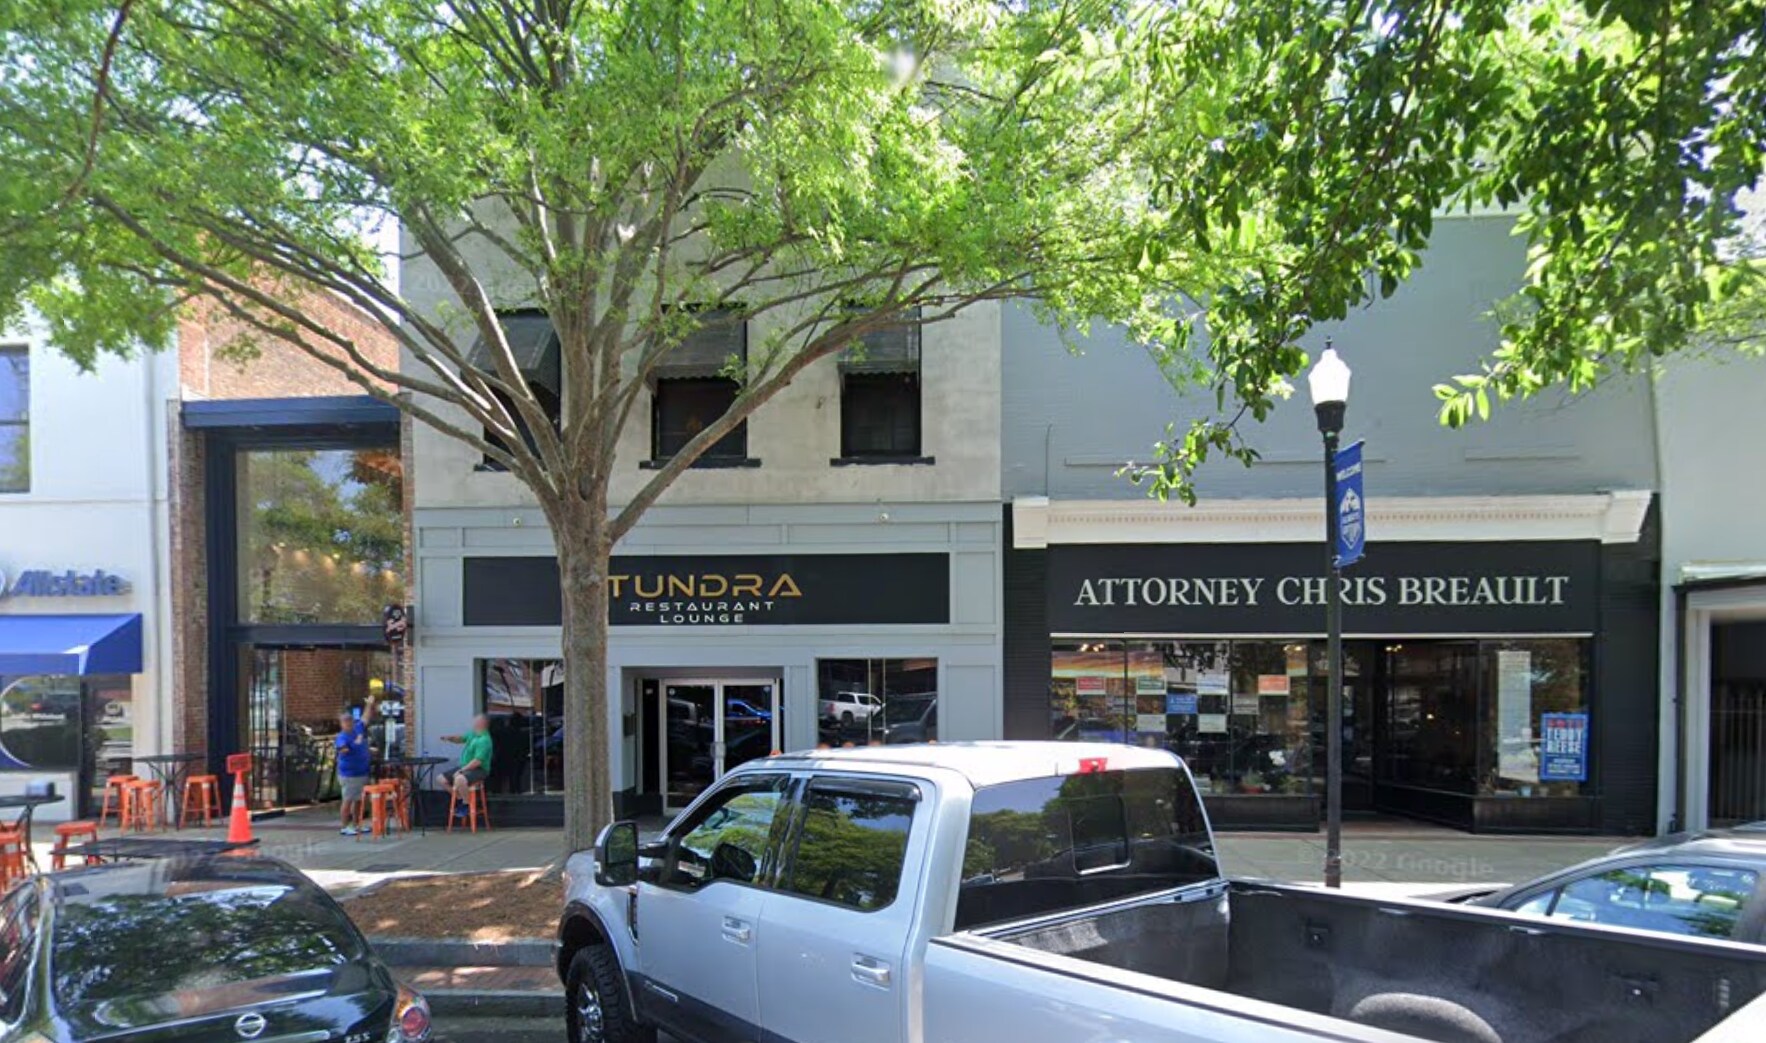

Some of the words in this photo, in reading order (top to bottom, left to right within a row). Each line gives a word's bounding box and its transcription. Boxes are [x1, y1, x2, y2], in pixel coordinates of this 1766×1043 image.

[607, 573, 803, 598] TUNDRA
[1073, 577, 1265, 606] ATTORNEY
[1398, 576, 1570, 605] BREAULT
[629, 601, 775, 612] RESTAURANT
[659, 613, 744, 624] LOUNGE
